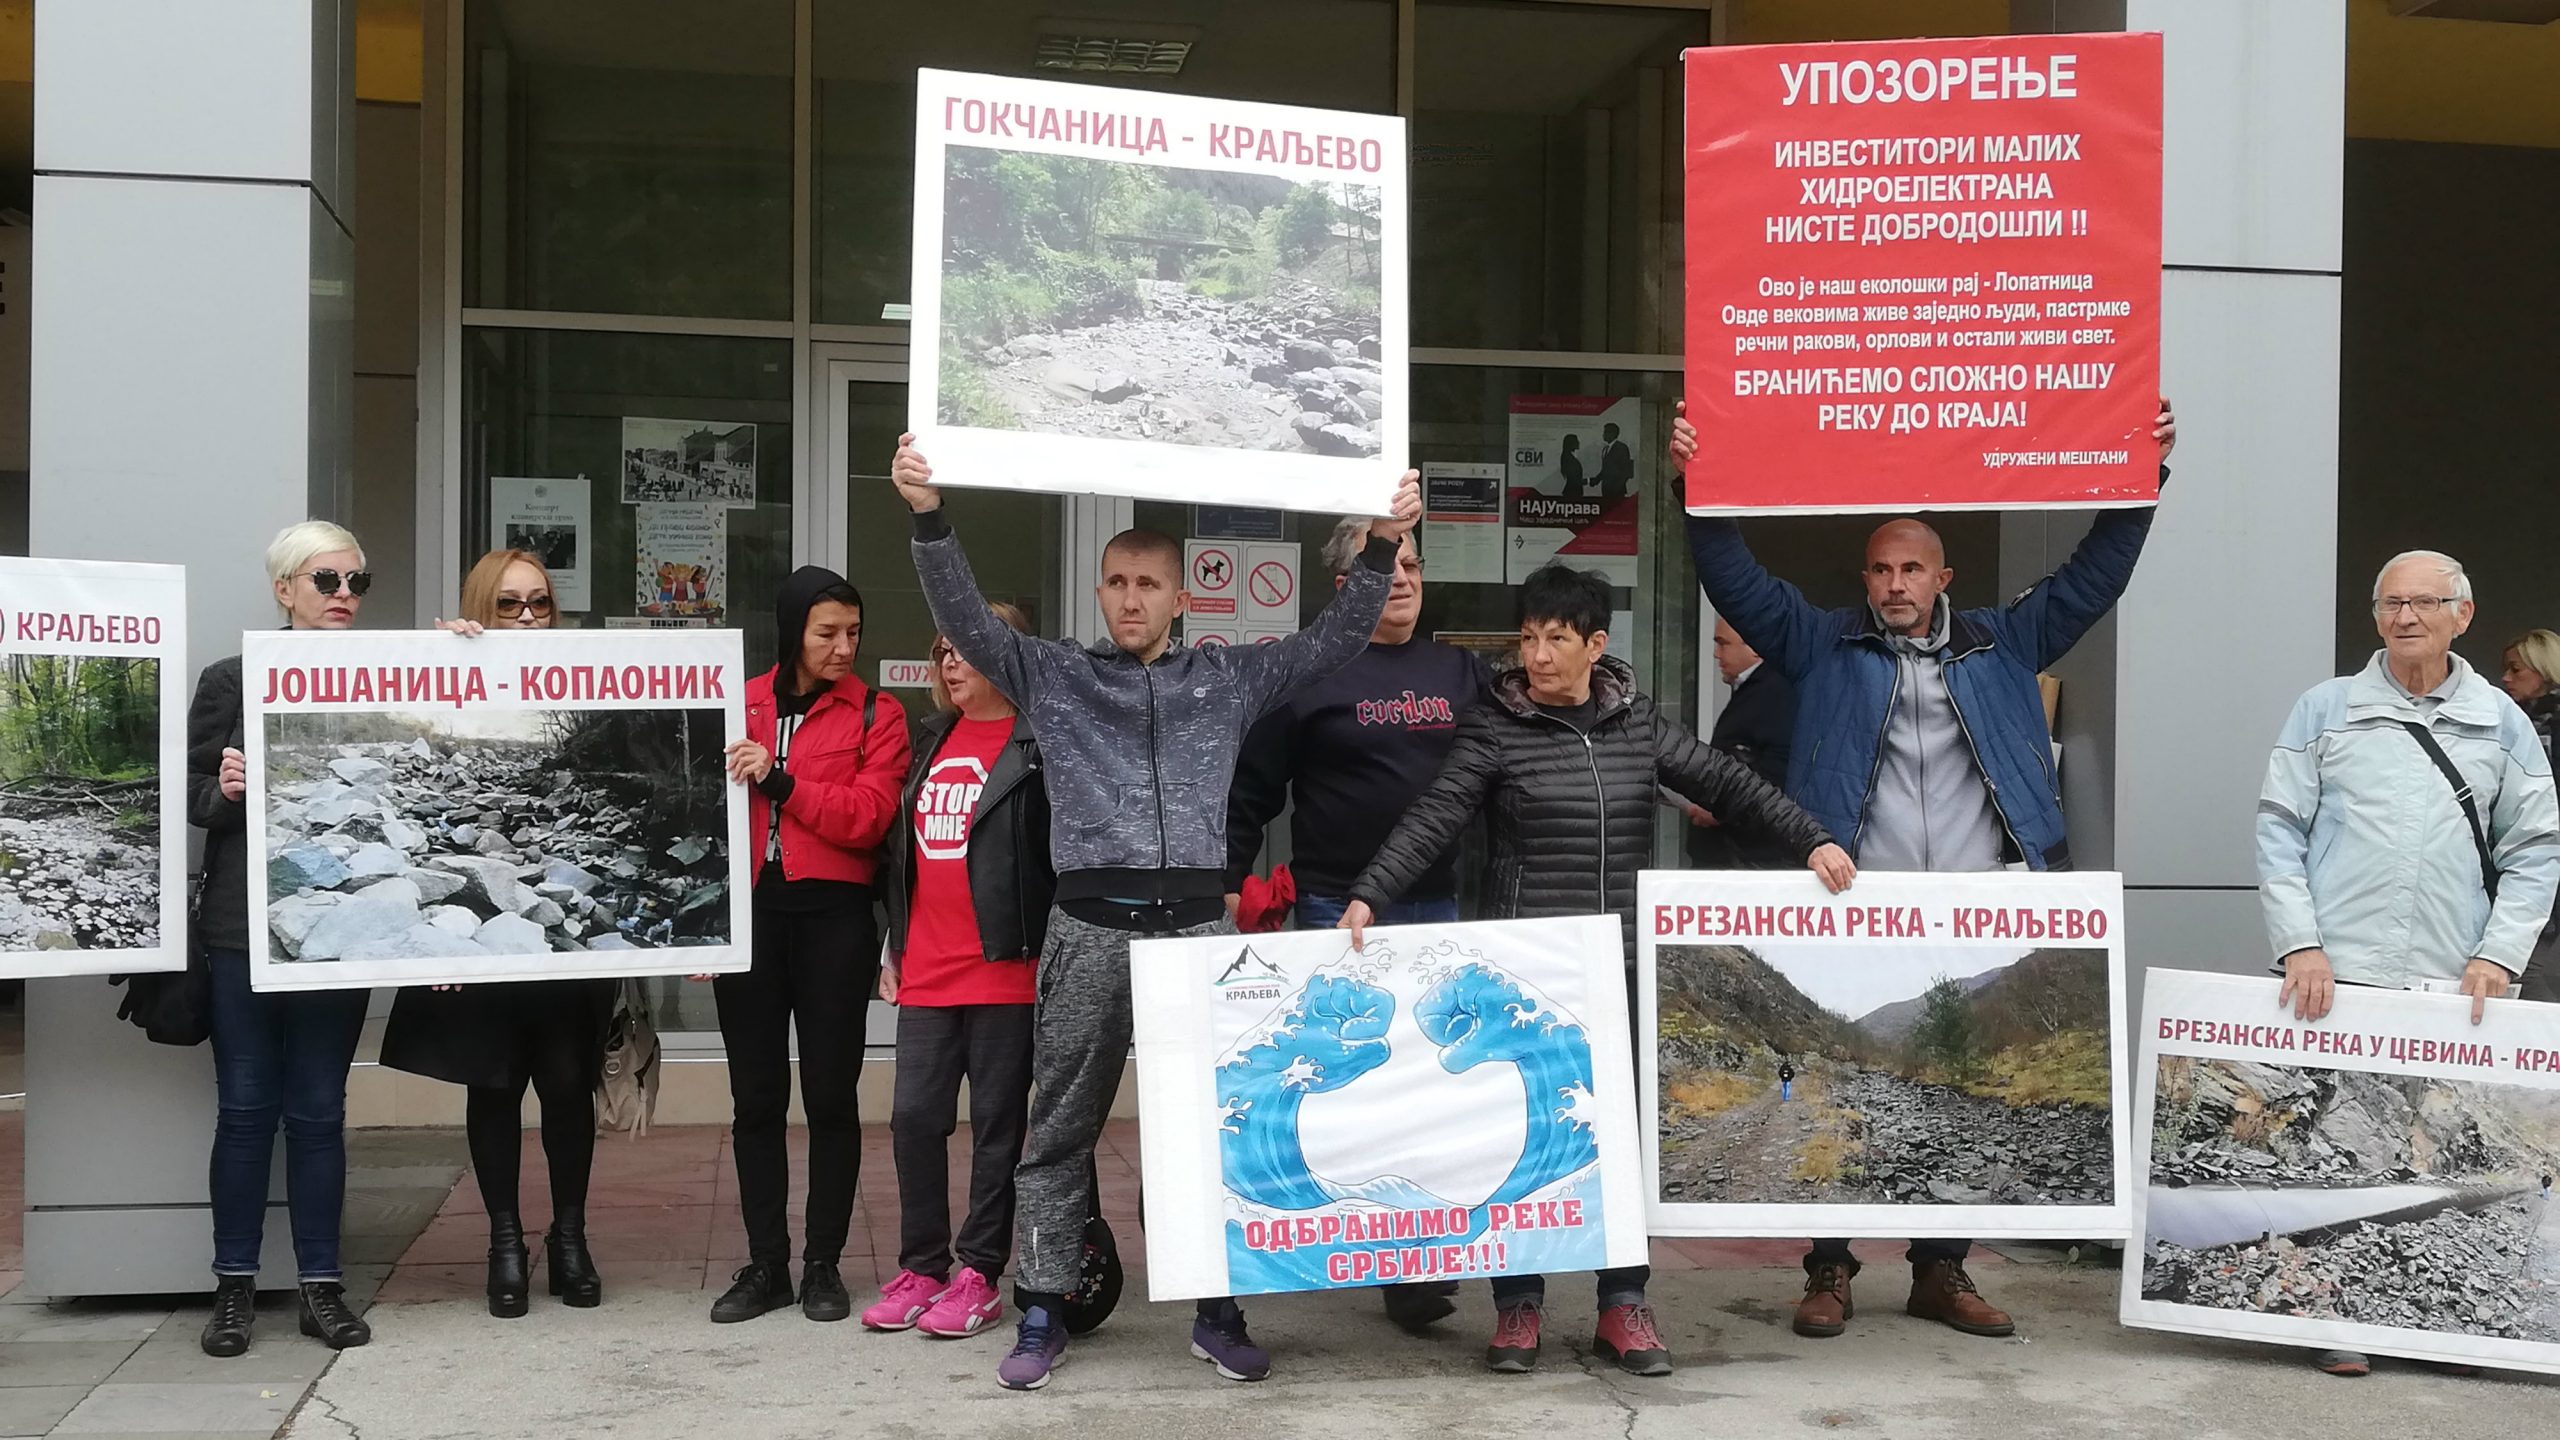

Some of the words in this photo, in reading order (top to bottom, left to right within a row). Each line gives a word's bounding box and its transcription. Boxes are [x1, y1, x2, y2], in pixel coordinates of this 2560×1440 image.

[1779, 55, 2078, 106] УПОЗОРЕЊЕ
[944, 96, 1169, 156] ГОКЧАНИЦА
[1209, 123, 1383, 174] КРАЉЕВО
[1775, 137, 1976, 168] ИНВЕСТИТОРИ
[1983, 134, 2081, 163] МАЛИХ
[1800, 173, 2054, 208] ХИДРОЕЛЕКТРАНА
[1766, 214, 1855, 243] НИСТЕ
[1862, 210, 2063, 246] ДОБРОДОШЛИ
[1759, 277, 1795, 297] Ово
[1799, 275, 1815, 300] је
[1819, 278, 1856, 296] наш
[1860, 276, 1948, 295] еколошки
[1953, 272, 1979, 298] рај
[1994, 272, 2093, 294] Лопатница
[1722, 305, 1768, 327] Овде
[1773, 304, 1859, 324] вековима
[1863, 304, 1909, 321] живе
[1913, 300, 1981, 325] заједно
[1985, 302, 2042, 324] људи,
[2046, 300, 2131, 321] пастрмке
[1735, 336, 1788, 355] речни
[1793, 334, 1861, 354] ракови,
[1866, 331, 1932, 352] орлови
[1937, 331, 1947, 347] и
[1953, 329, 2016, 347] остали
[2020, 329, 2067, 346] живи
[2072, 327, 2116, 345] свет.
[1734, 366, 1902, 396] БРАНИЋЕМО
[1910, 364, 2028, 392] СЛОЖНО
[2035, 363, 2116, 390] НАШУ
[1818, 404, 1885, 431] РЕКУ
[1890, 402, 1930, 435] ДО
[1937, 401, 2027, 428] КРАЈА!
[1515, 451, 1543, 463] СВИ
[1983, 452, 2056, 468] УДРУЖЕНИ
[2059, 450, 2128, 466] МЕШТАНИ
[1520, 499, 1600, 518] НАЈУправа
[17, 611, 161, 644] КРАЉЕВО
[262, 666, 488, 709] ЈОШАНИЦА
[520, 665, 725, 701] КОПАОНИК
[1356, 690, 1454, 726] cordon
[917, 781, 984, 814] STOP
[924, 815, 966, 841] МНЕ
[1654, 905, 1837, 937] БРЕЗАНСКА
[1846, 906, 1926, 938] РЕКА
[1952, 907, 2108, 940] КРАЉЕВО
[1226, 988, 1281, 1001] КРАЉЕВА
[2158, 1018, 2295, 1050] БРЕЗАНСКА
[2302, 1030, 2363, 1057] РЕКА
[2369, 1035, 2385, 1059] У
[2389, 1038, 2495, 1067] ЦЕВИМА
[1245, 1206, 1469, 1253] ОДБРАНИМО
[1489, 1198, 1585, 1234] РЕКЕ
[1327, 1242, 1508, 1283] СРБИЈЕ!!!
